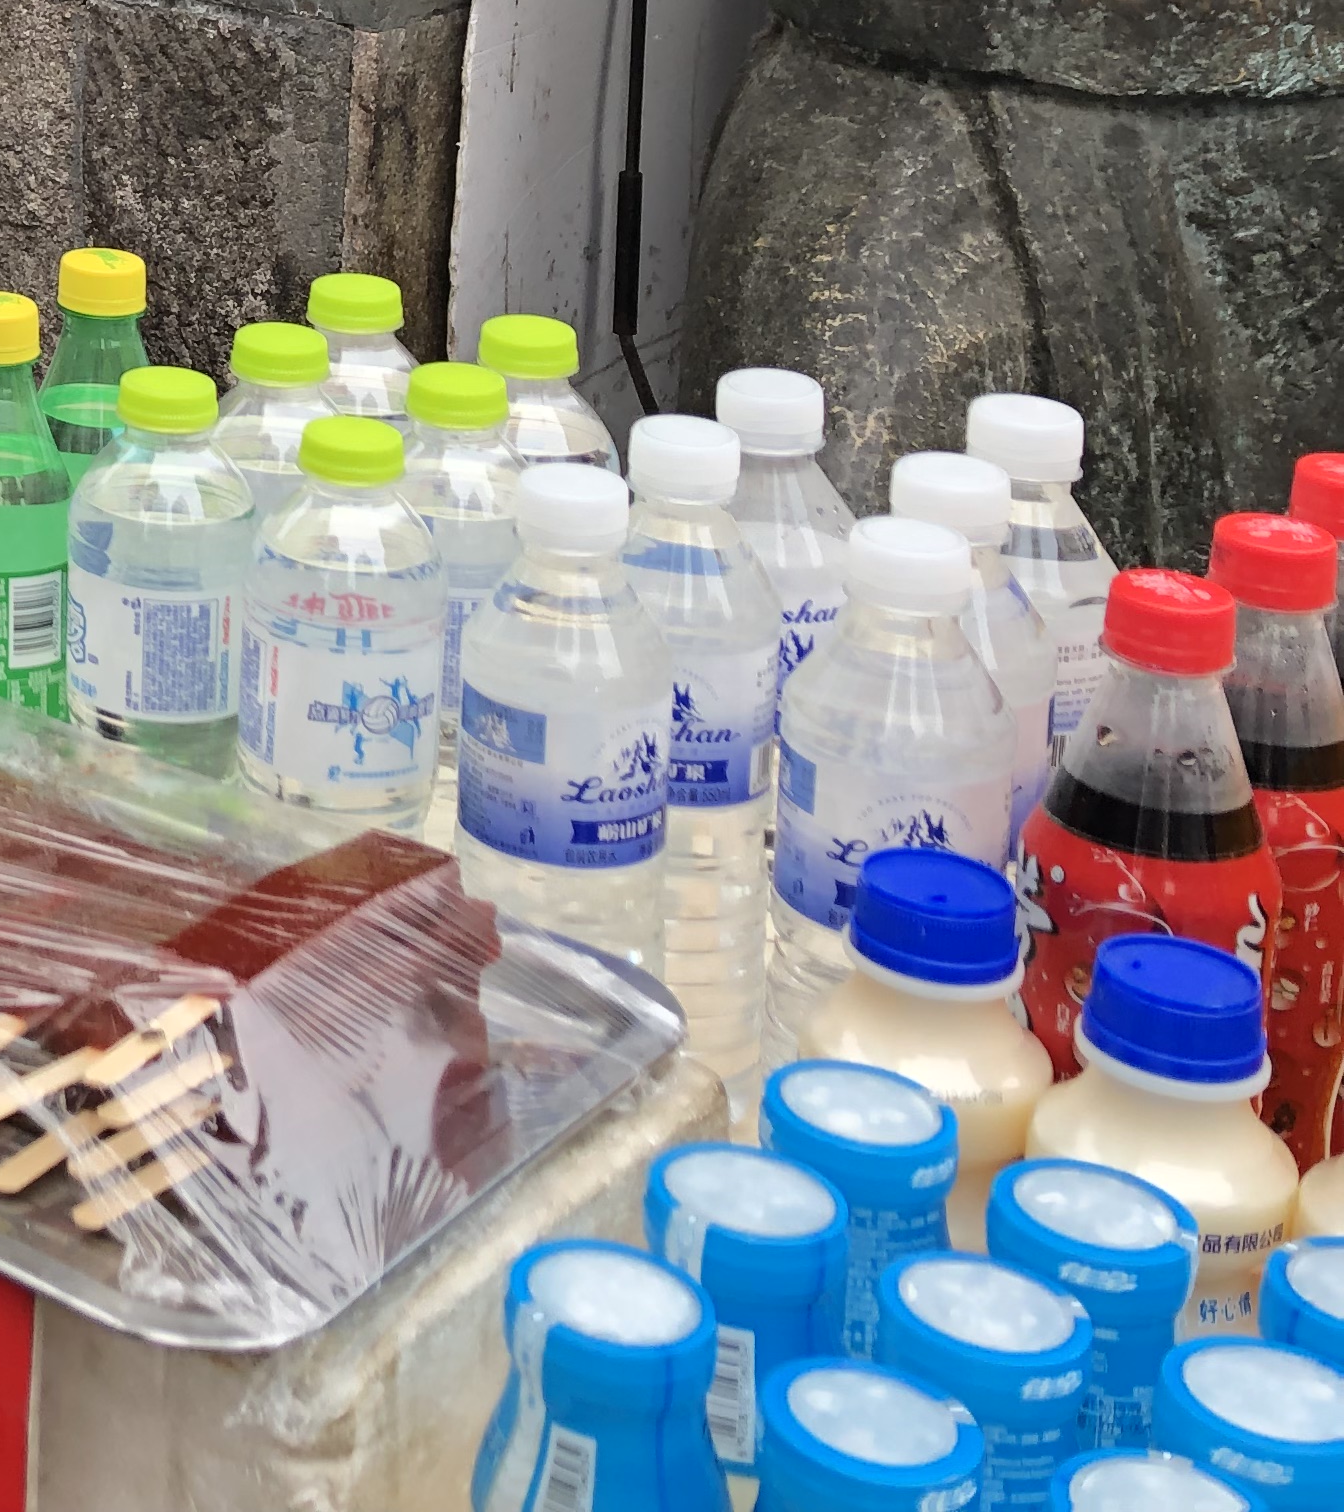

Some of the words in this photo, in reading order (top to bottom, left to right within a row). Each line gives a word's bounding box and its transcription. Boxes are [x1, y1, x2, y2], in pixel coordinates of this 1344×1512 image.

[1198, 1223, 1284, 1256] 品有限公司
